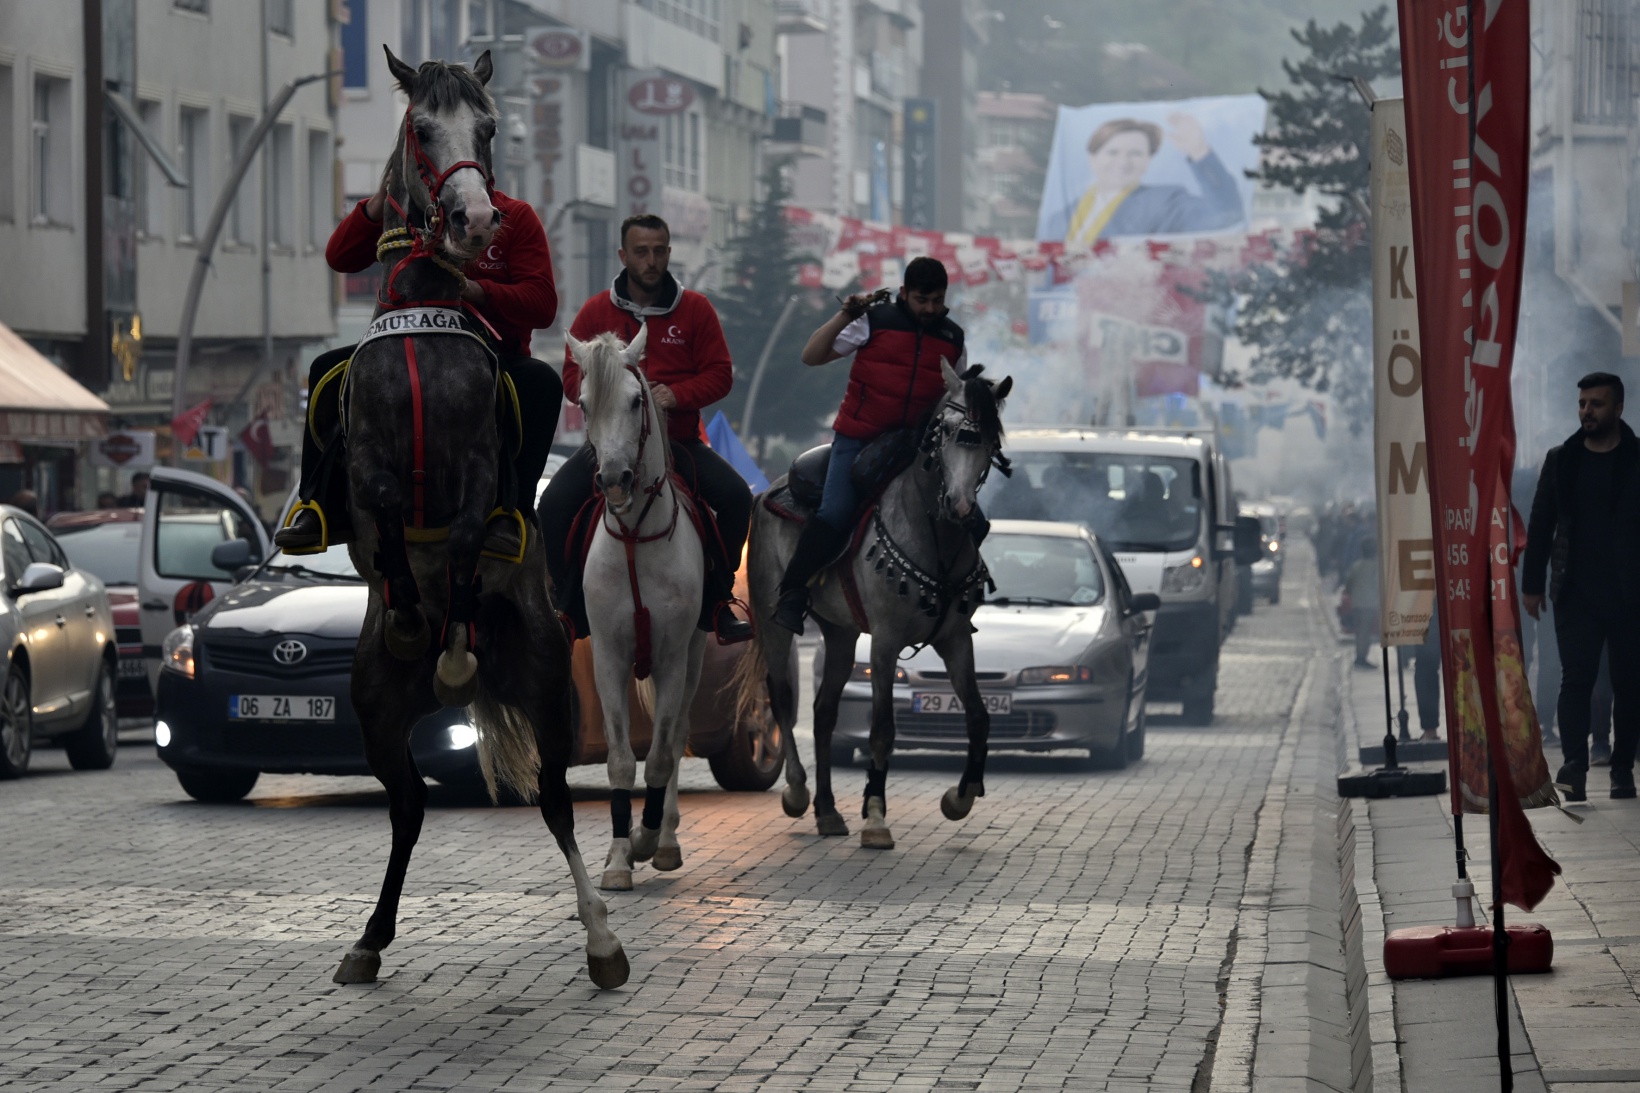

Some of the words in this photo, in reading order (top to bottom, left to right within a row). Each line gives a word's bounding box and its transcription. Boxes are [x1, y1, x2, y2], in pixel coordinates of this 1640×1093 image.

[360, 310, 461, 343] EMURAĞA
[241, 697, 259, 716] 06
[273, 698, 291, 716] ZA
[308, 699, 333, 717] 187
[923, 696, 942, 711] 29
